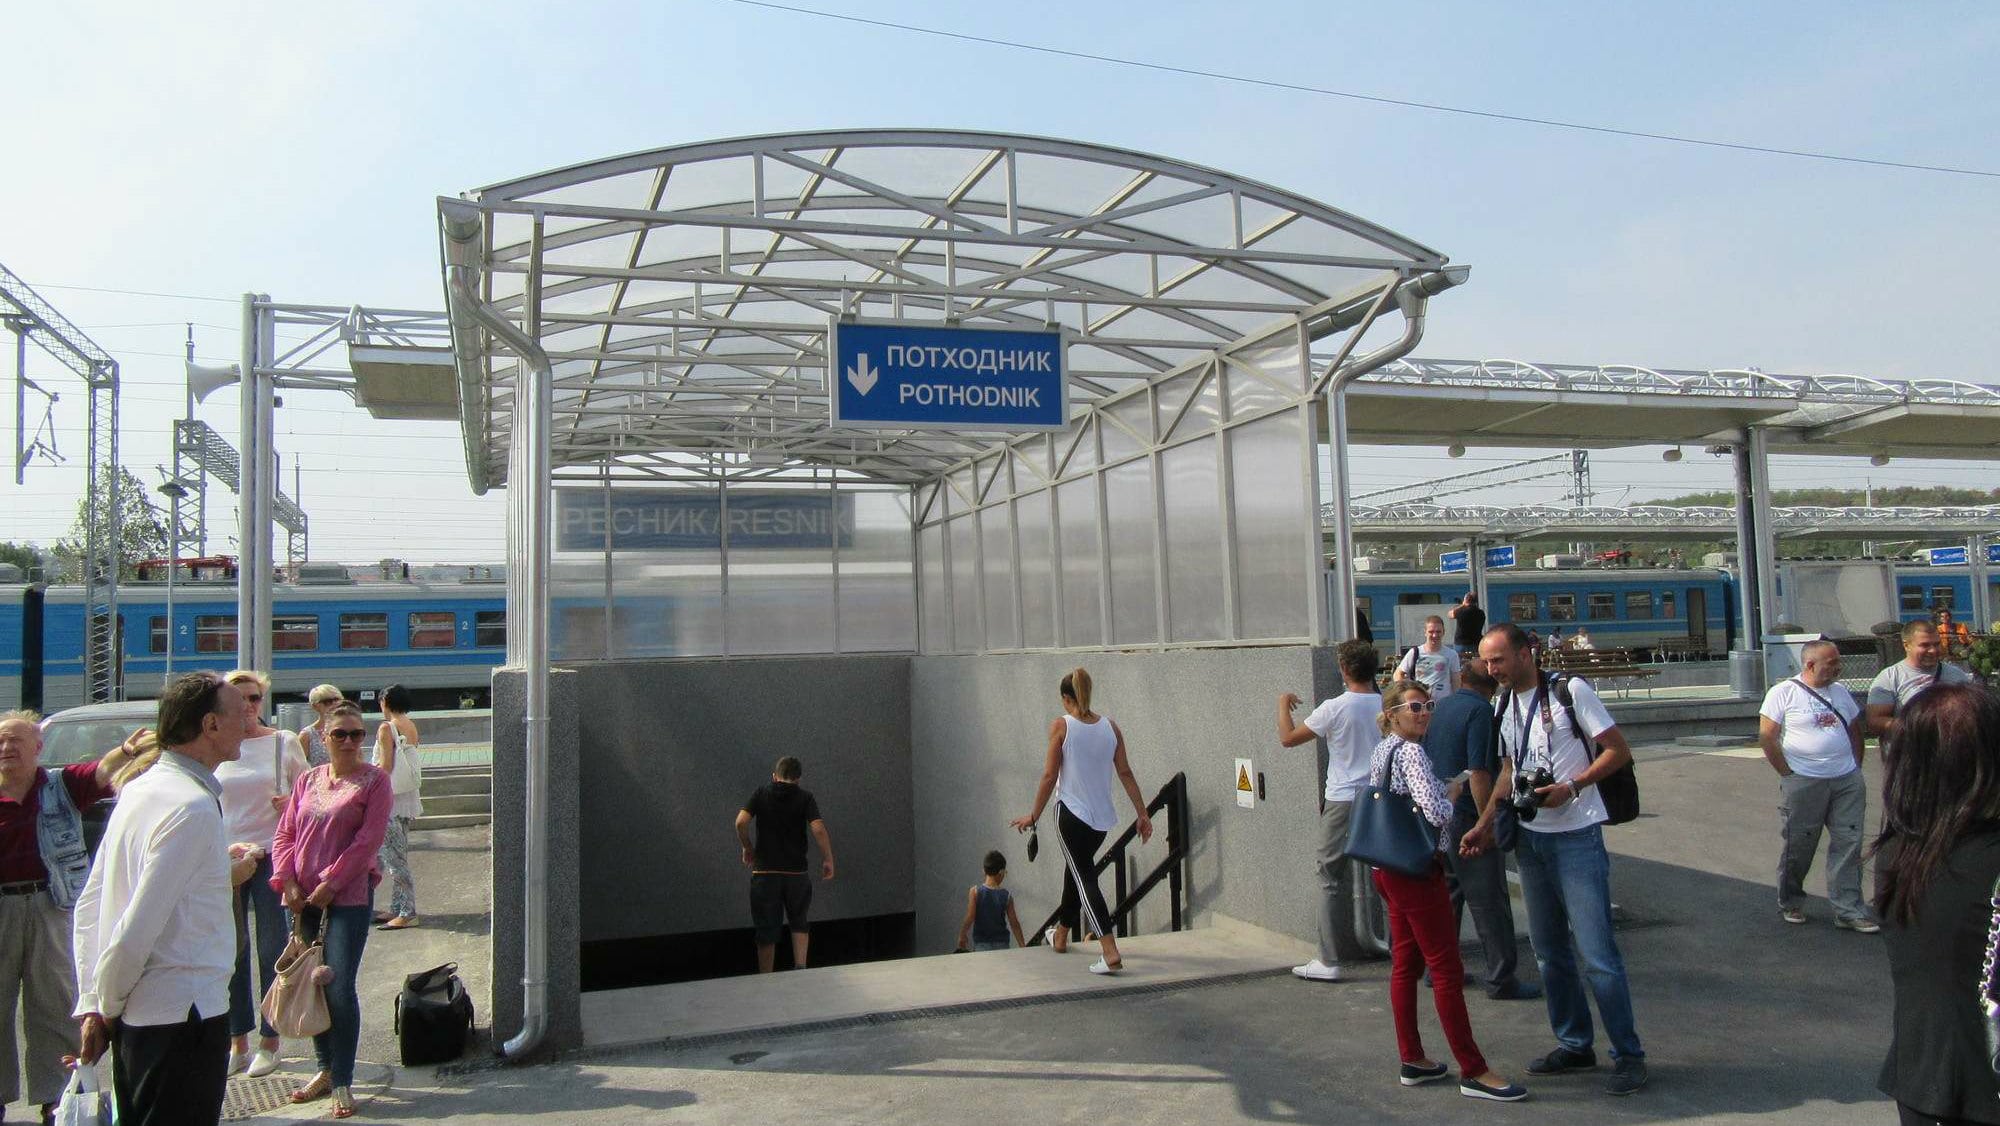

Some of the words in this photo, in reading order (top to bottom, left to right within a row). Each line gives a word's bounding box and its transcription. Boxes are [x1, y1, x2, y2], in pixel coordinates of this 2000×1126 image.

[887, 345, 1051, 375] ПОТХОДНИК
[900, 383, 1041, 408] POTHODNIK
[562, 507, 709, 535] РЕСНИК
[727, 508, 851, 535] RESNIK
[180, 624, 188, 635] 2
[463, 620, 469, 630] 2
